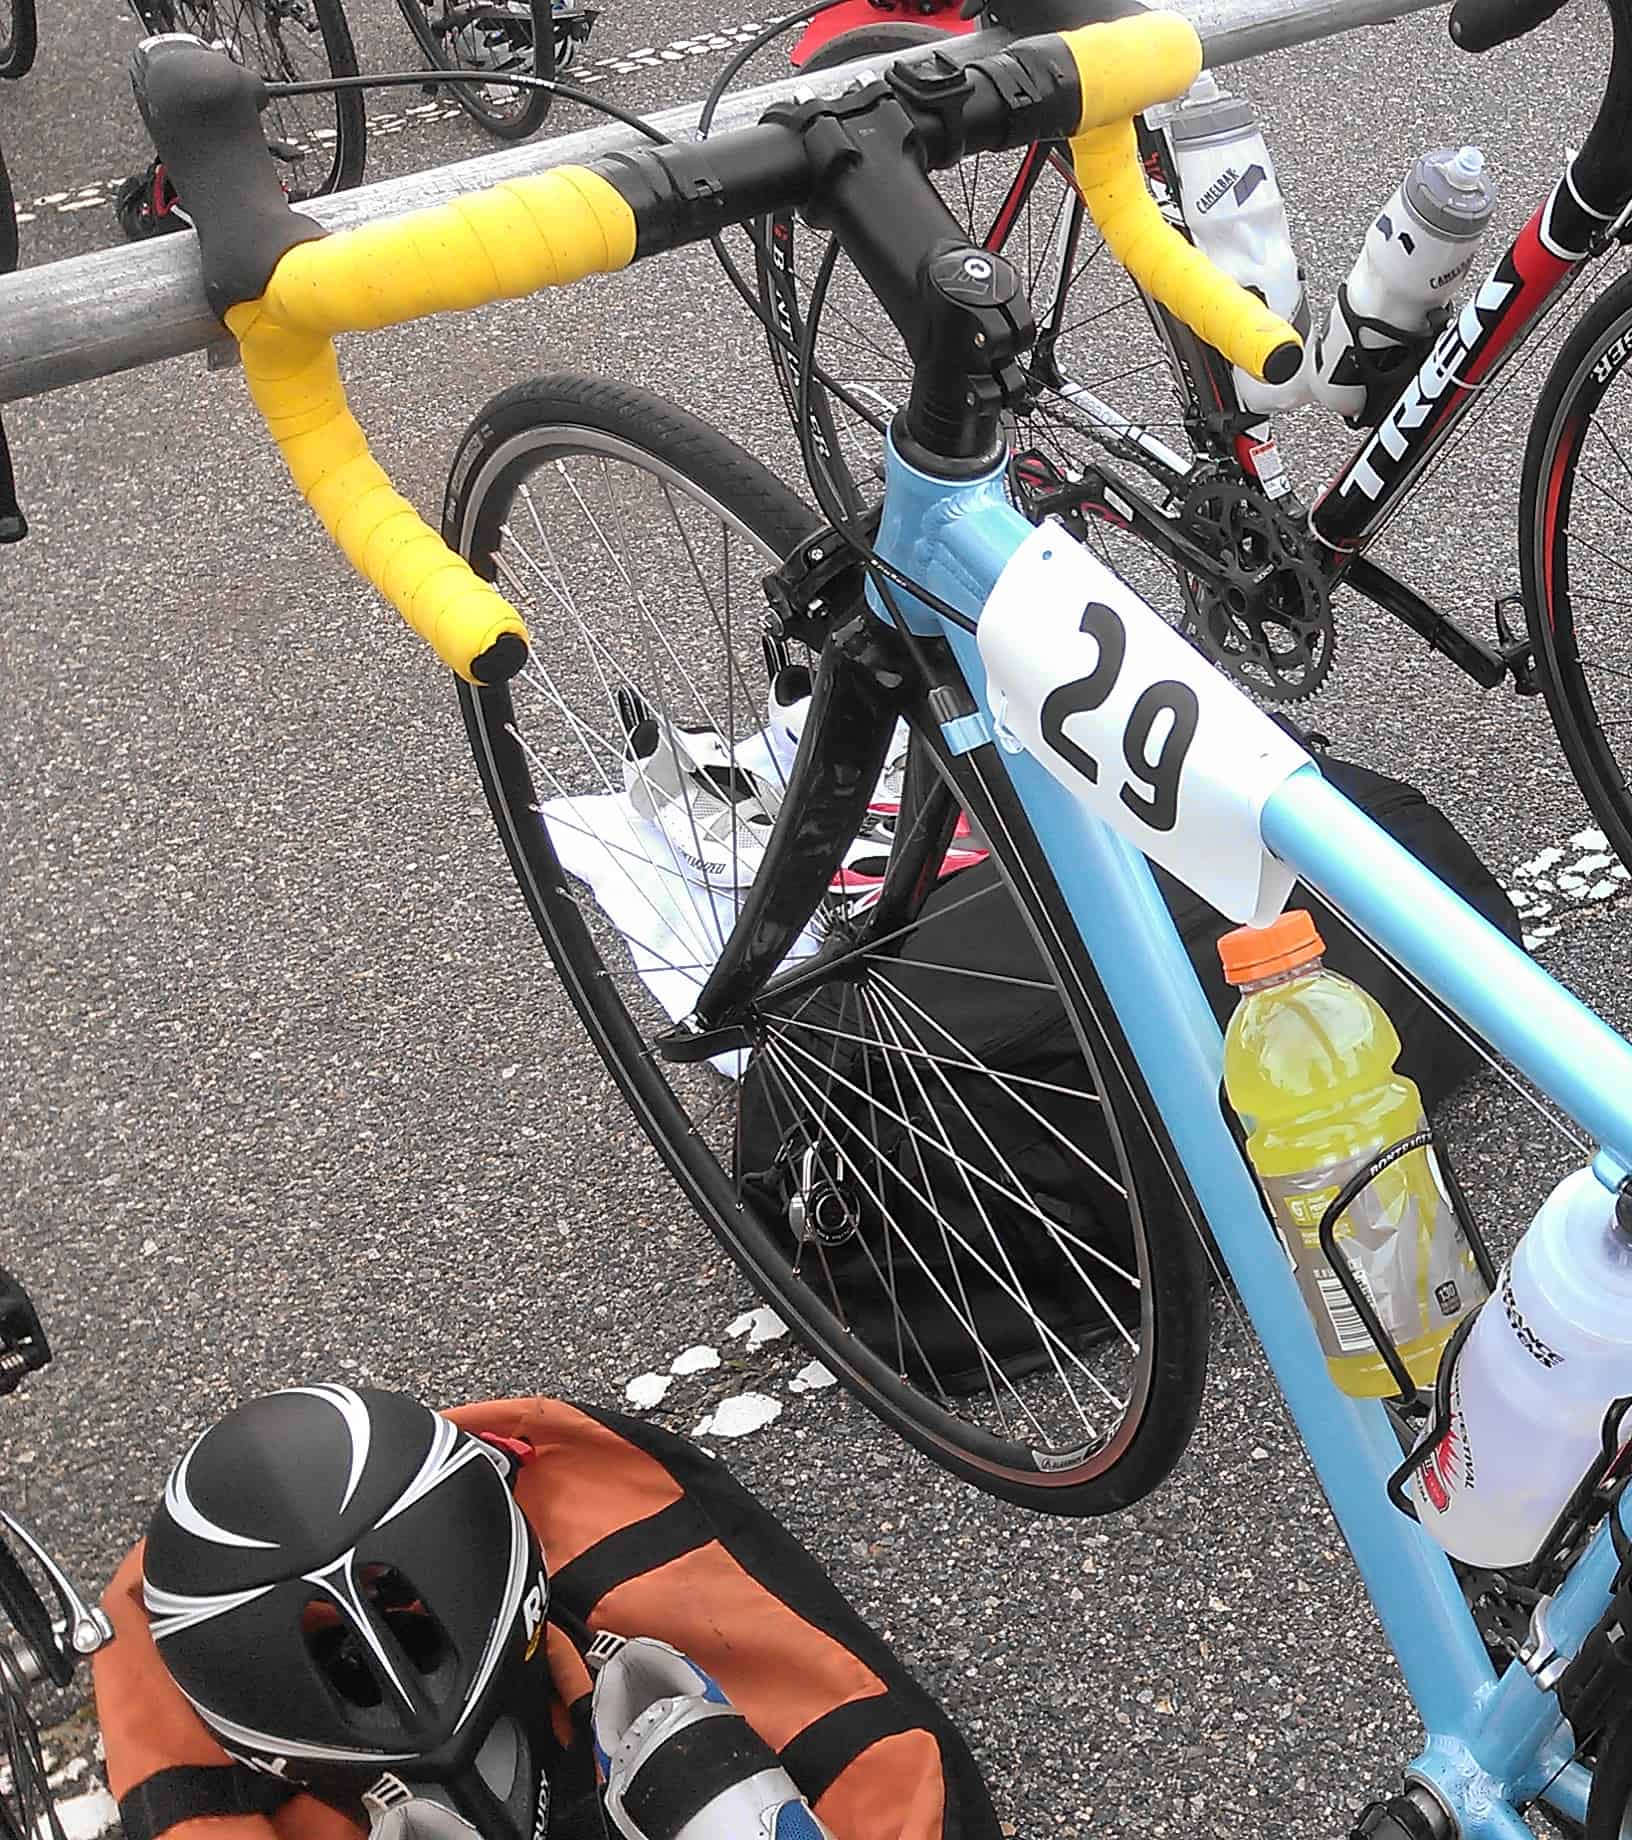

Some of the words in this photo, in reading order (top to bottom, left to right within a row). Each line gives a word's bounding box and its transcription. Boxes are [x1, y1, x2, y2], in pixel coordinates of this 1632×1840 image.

[1196, 168, 1240, 214] CAMELBAK
[1339, 262, 1516, 501] TREK
[1039, 601, 1200, 832] 29
